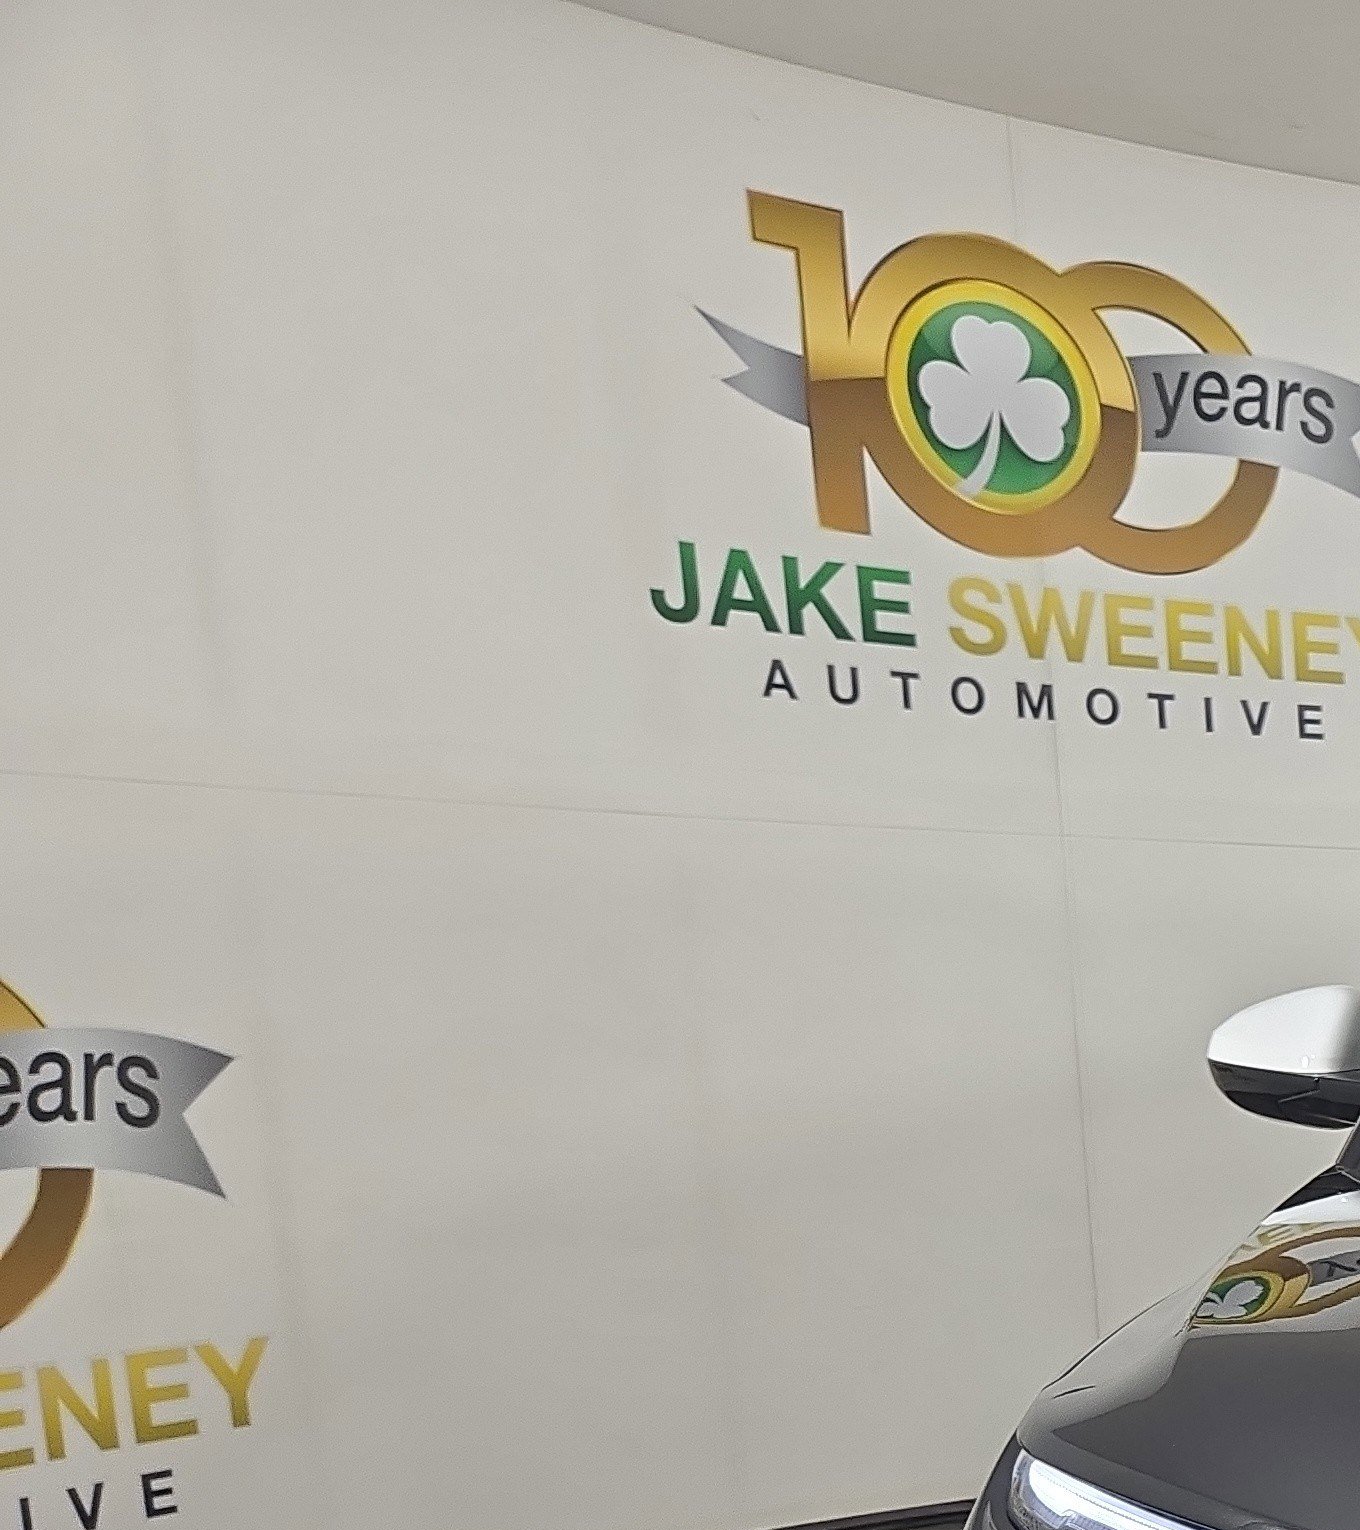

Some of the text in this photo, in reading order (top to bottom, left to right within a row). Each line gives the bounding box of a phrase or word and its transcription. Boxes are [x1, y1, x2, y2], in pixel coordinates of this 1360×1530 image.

[1152, 364, 1336, 444] years
[649, 540, 917, 647] JAKE
[762, 659, 1326, 740] AUTOMOTIVE
